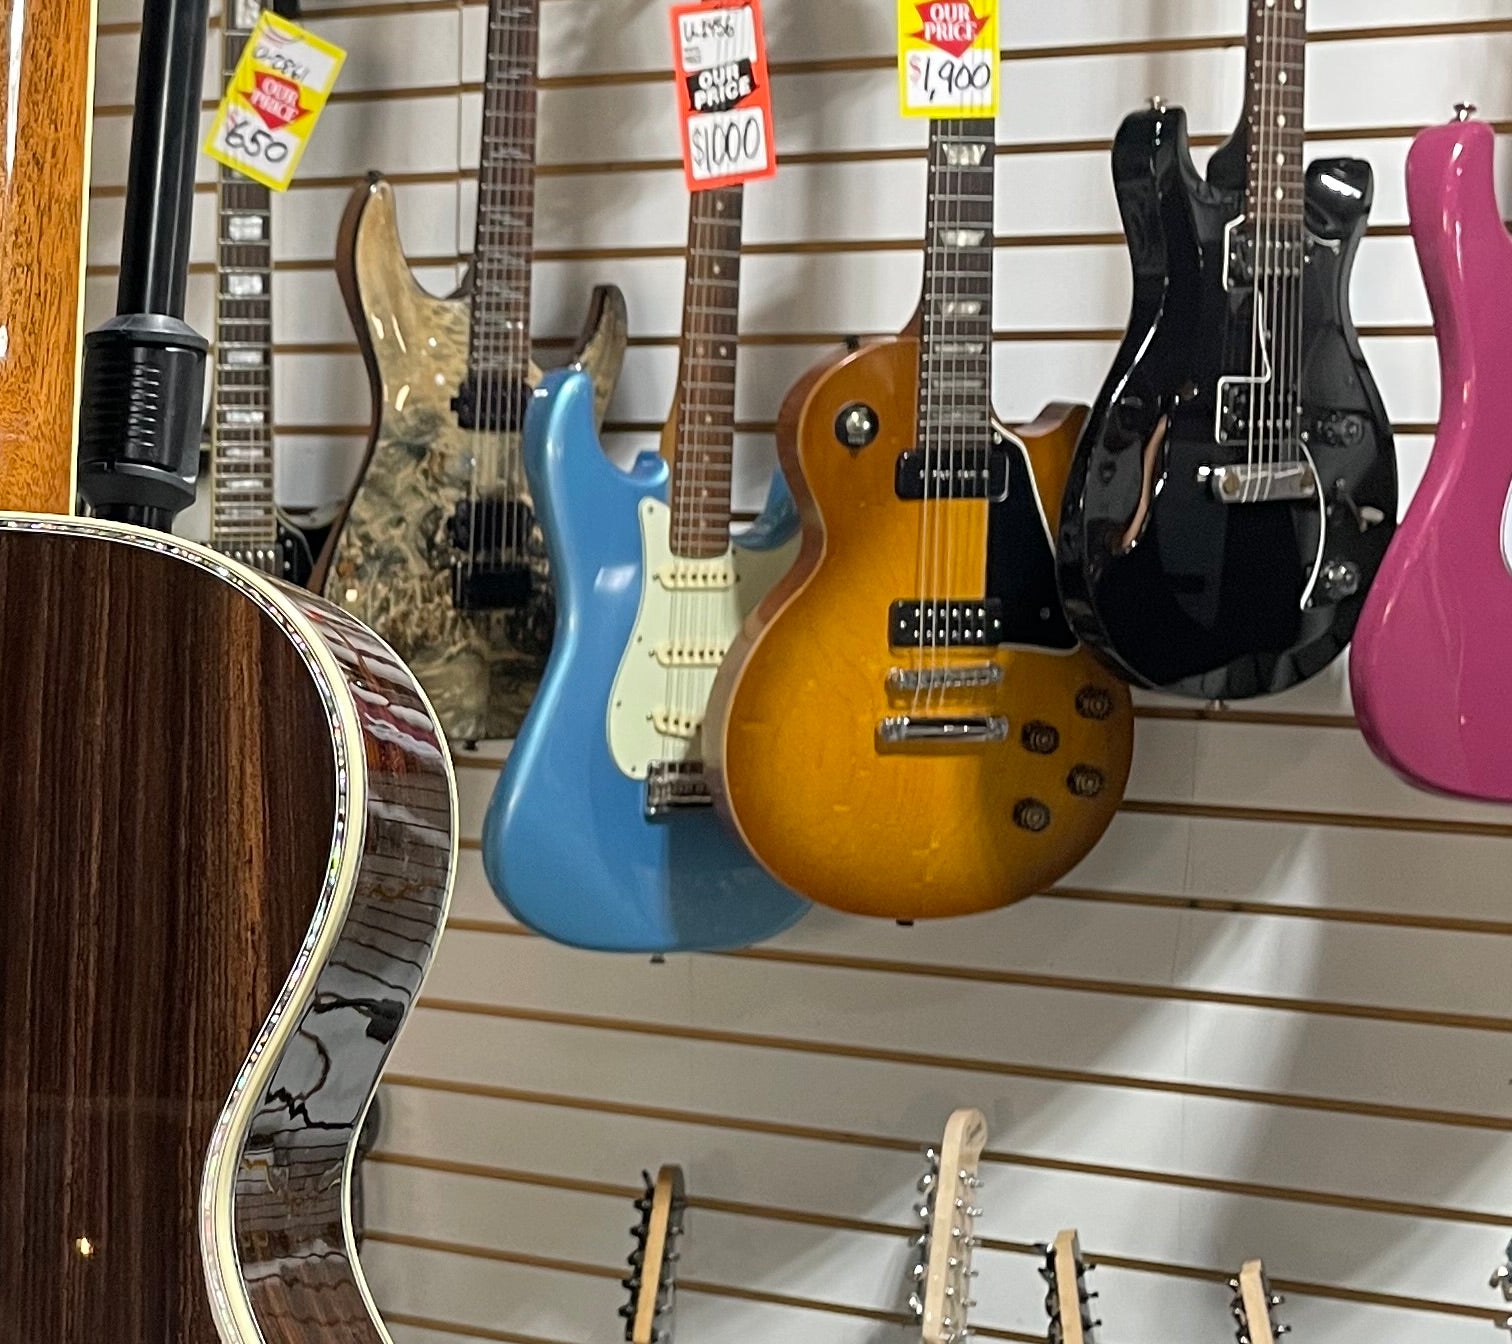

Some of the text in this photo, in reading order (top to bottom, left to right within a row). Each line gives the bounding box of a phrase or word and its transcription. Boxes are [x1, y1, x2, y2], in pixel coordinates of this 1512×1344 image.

[929, 3, 972, 22] OUR
[924, 21, 978, 42] PRICE
[698, 63, 740, 89] OUR
[262, 77, 300, 104] OUR
[694, 75, 751, 111] PRICE
[251, 88, 300, 122] PRICE
[692, 116, 761, 177] $1000
